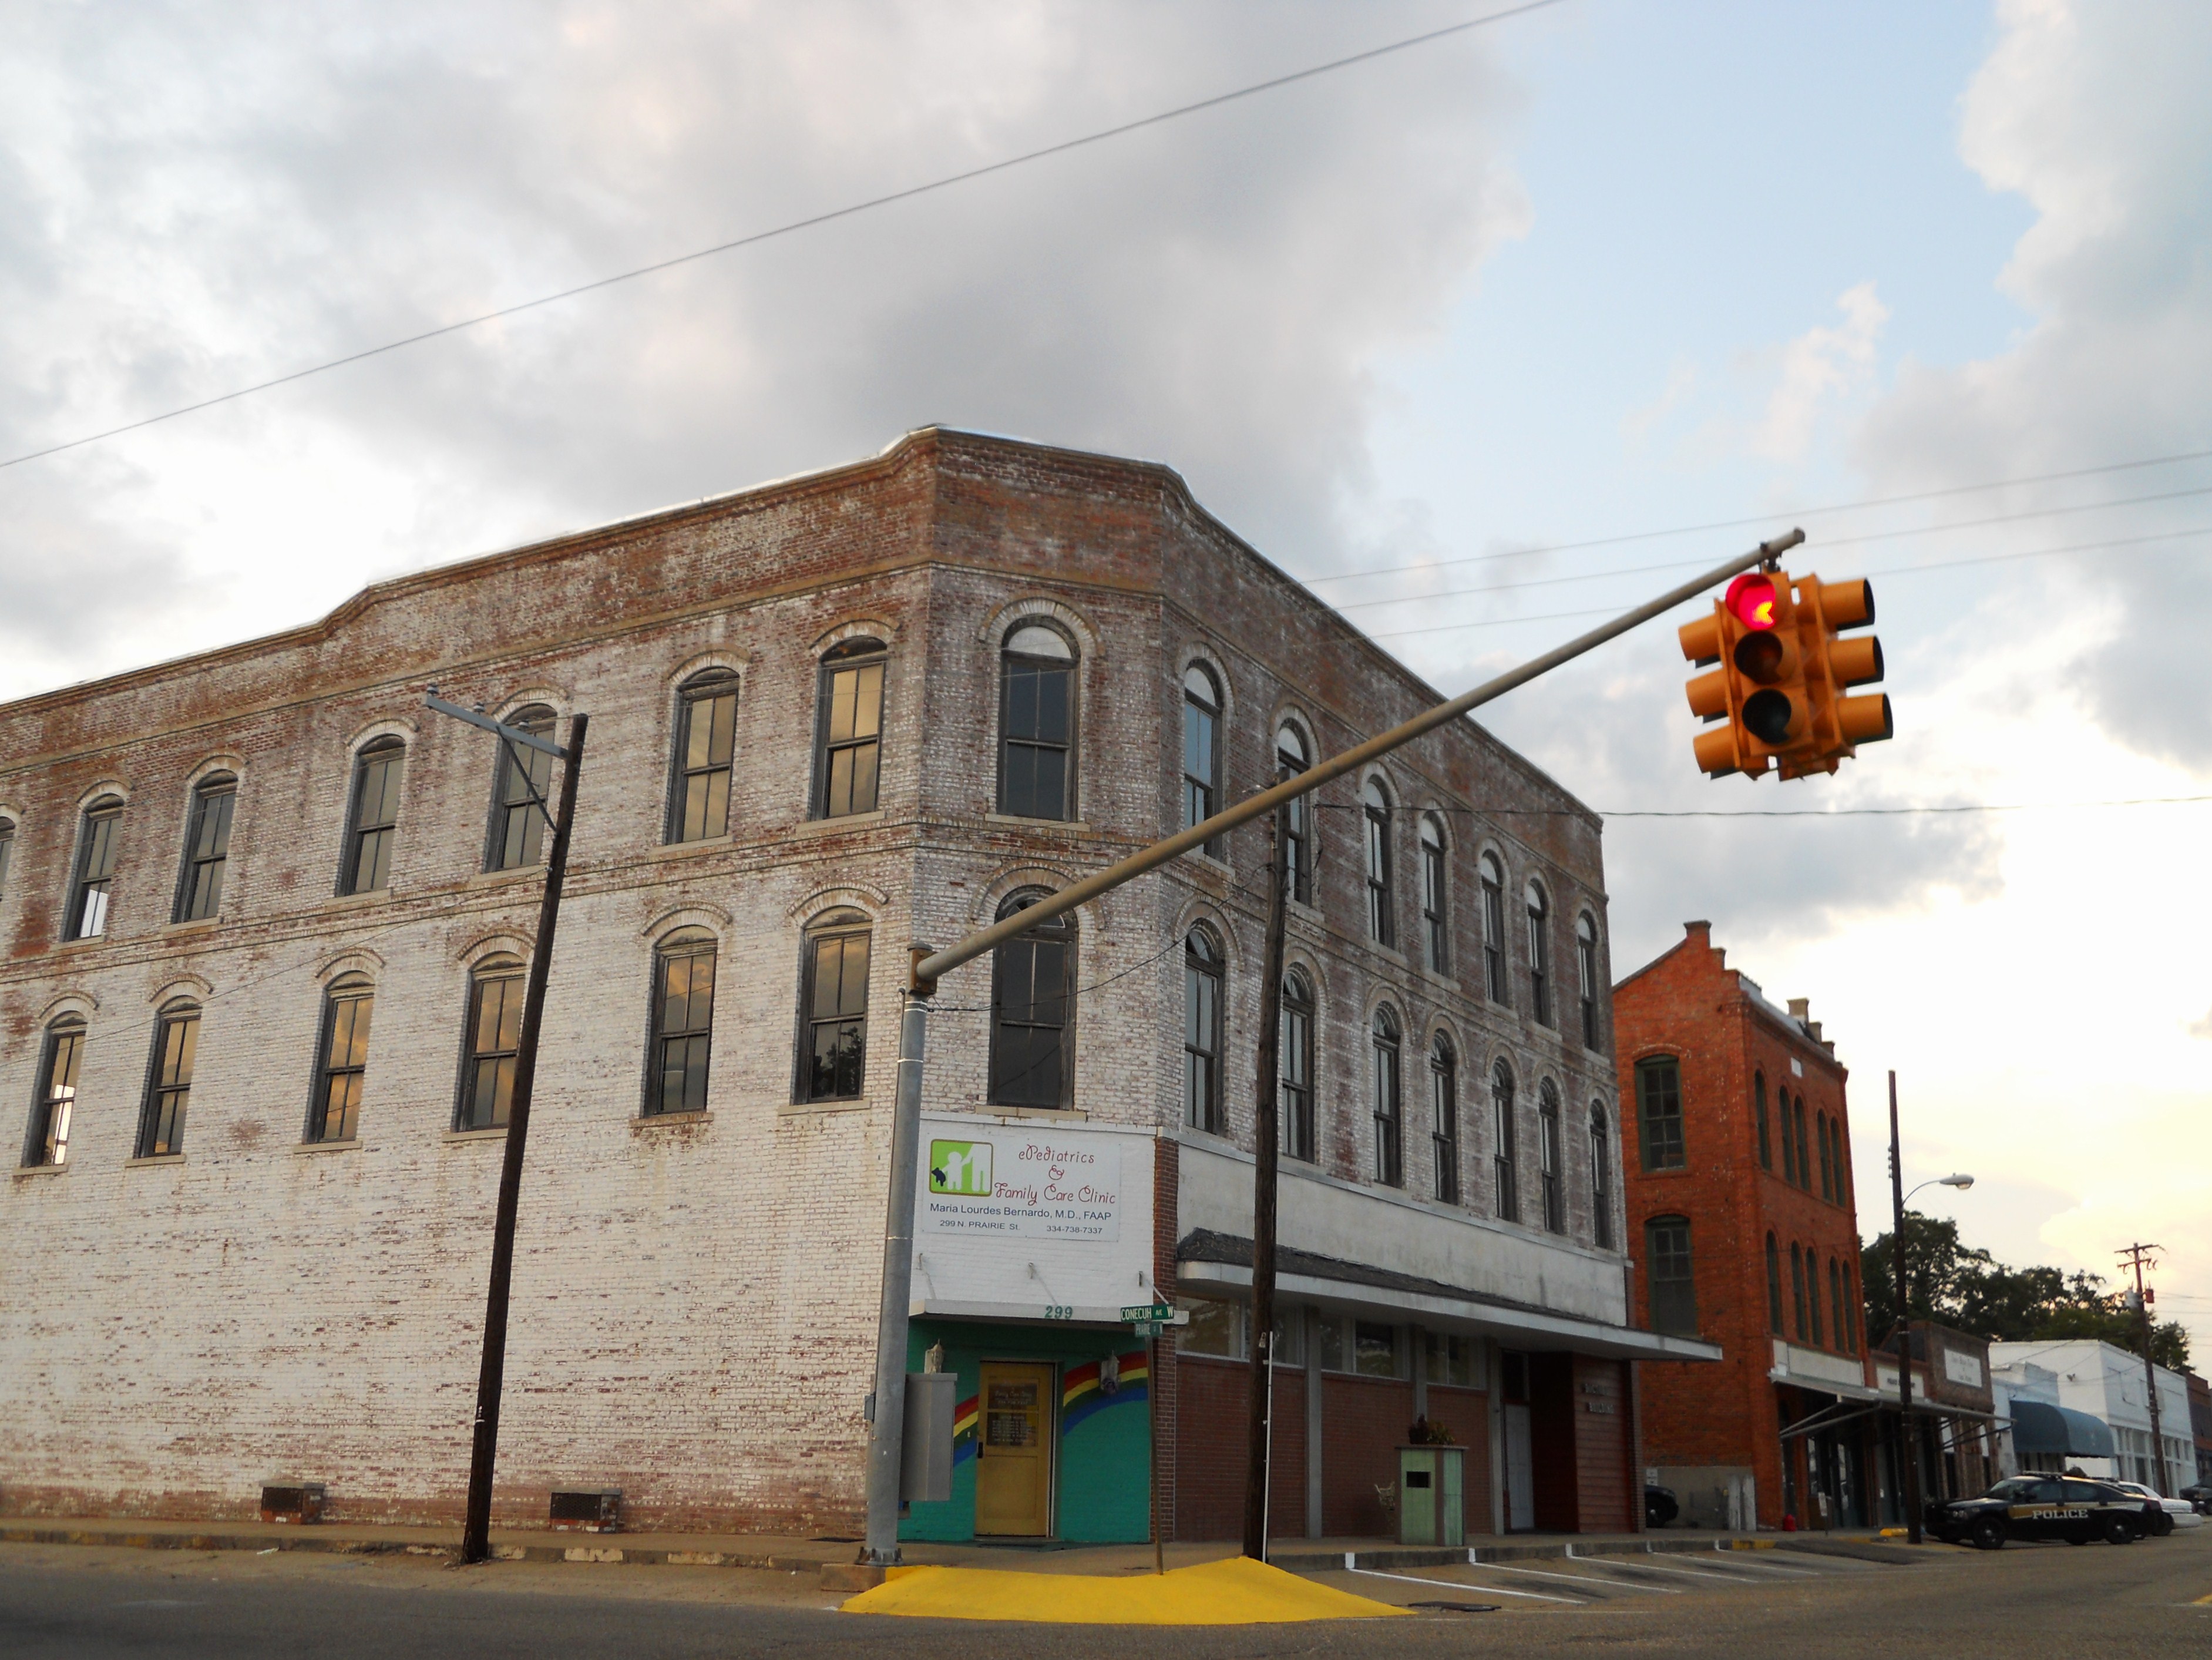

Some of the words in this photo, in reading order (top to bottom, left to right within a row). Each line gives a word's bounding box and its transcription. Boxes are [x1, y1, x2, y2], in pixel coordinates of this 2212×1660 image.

[1018, 1144, 1094, 1163] ePediatrics
[1048, 1164, 1064, 1180] &
[994, 1182, 1037, 1206] Family
[1044, 1184, 1074, 1201] Care
[1078, 1185, 1115, 1204] Clinic
[930, 1203, 958, 1213] Maria
[961, 1205, 1001, 1215] Lourdes
[1004, 1207, 1052, 1219] Bernardo,
[1055, 1209, 1081, 1220] M.D.,
[1084, 1211, 1111, 1221] FAAP
[969, 1221, 1005, 1229] PRAIRIE
[1047, 1225, 1102, 1234] 334-738-7337
[1044, 1305, 1073, 1319] 299
[1121, 1307, 1152, 1320] CONECUH
[1166, 1306, 1174, 1318] W
[2032, 1508, 2088, 1519] POLICE
